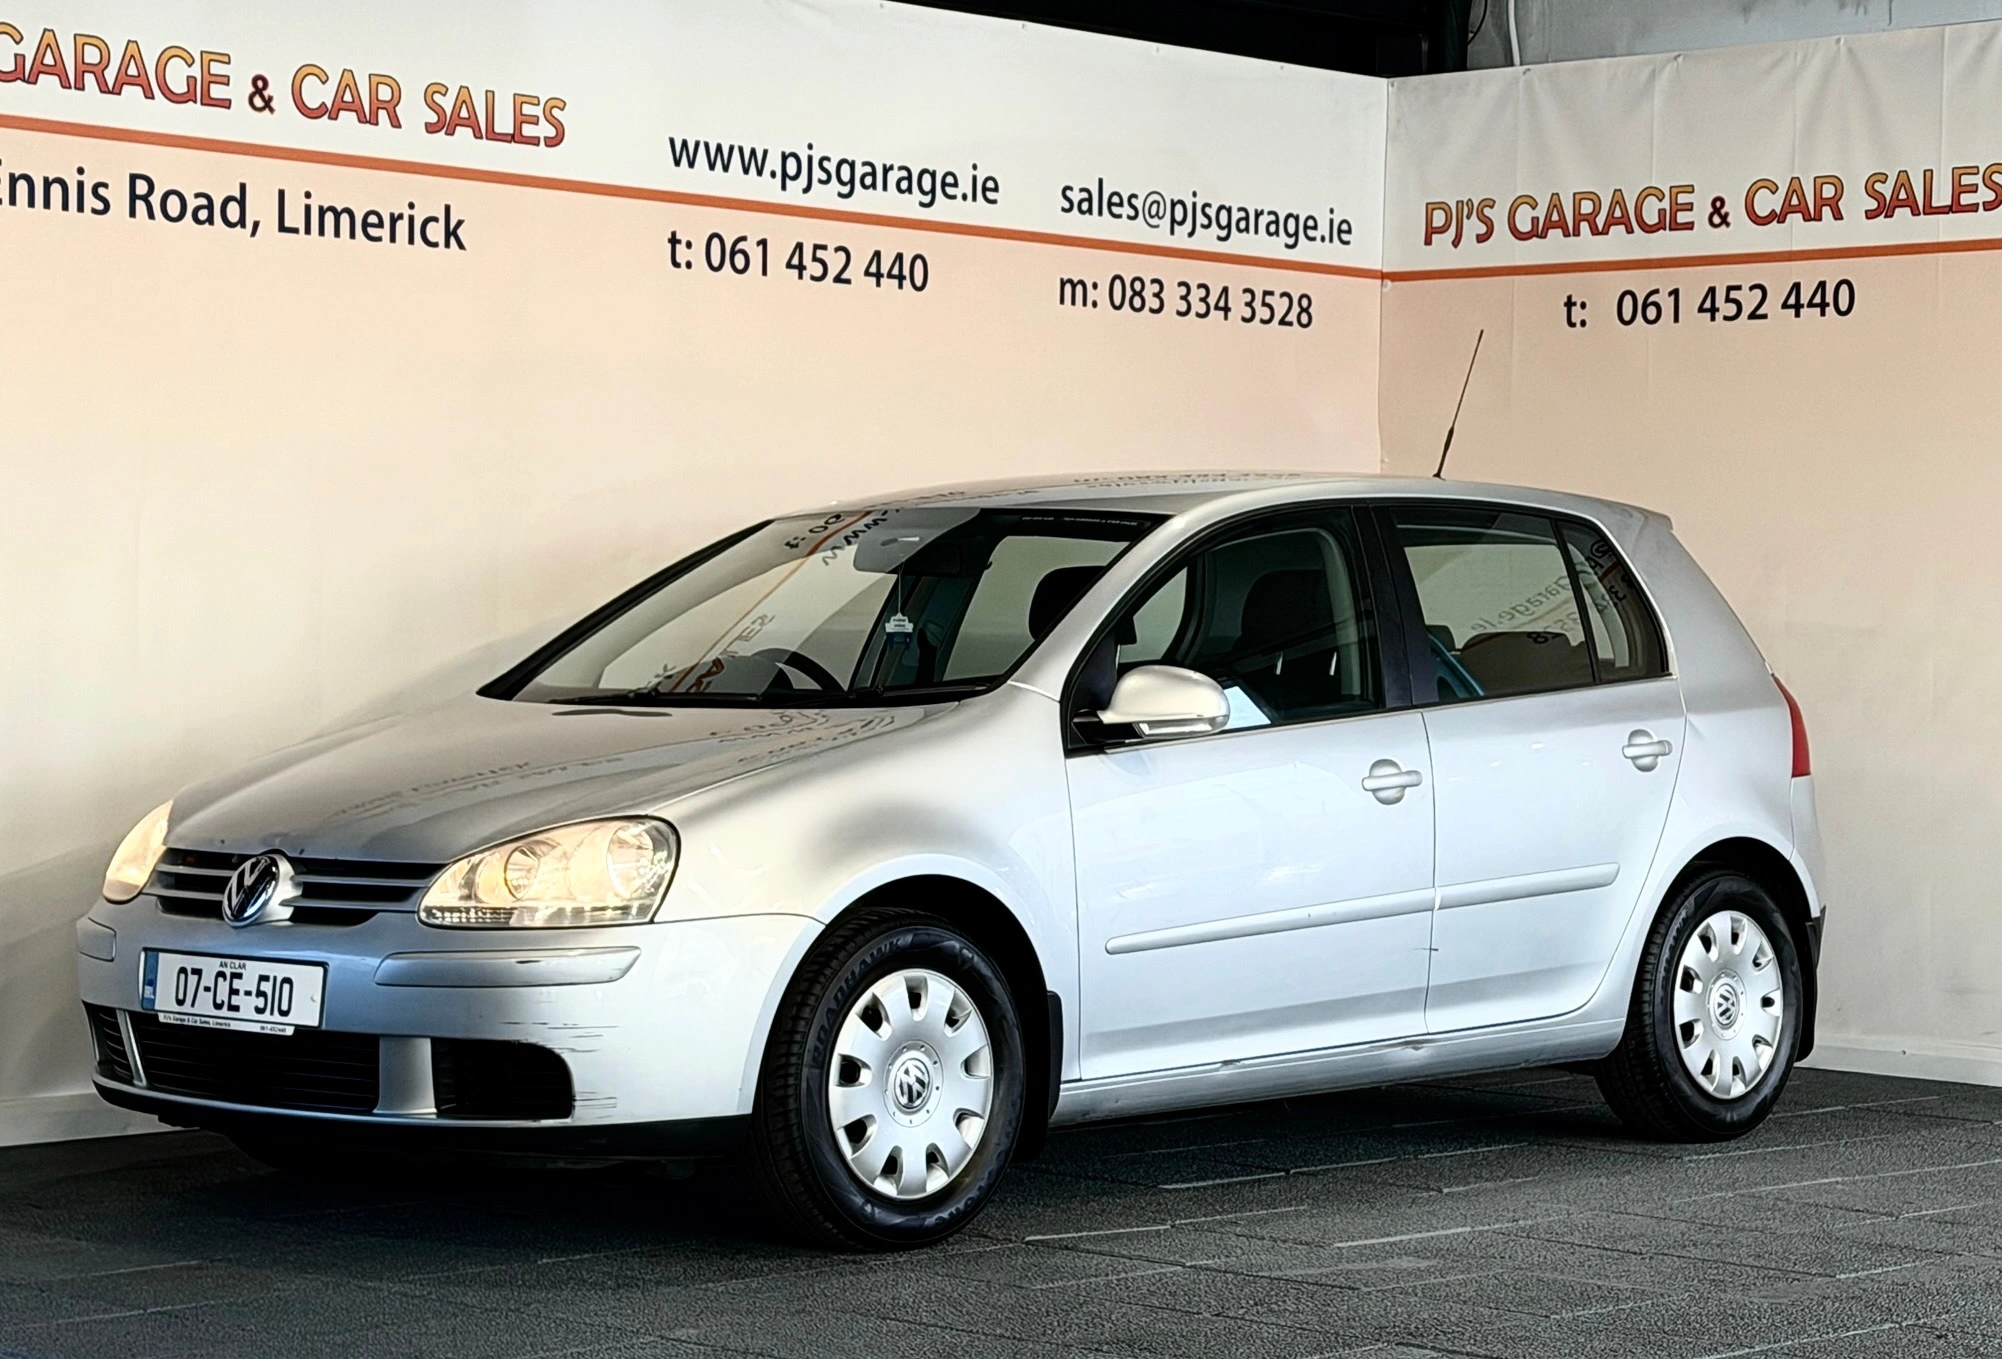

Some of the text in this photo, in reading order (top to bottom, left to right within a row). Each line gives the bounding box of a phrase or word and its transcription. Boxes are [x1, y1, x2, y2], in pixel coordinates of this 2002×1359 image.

[248, 74, 275, 114] &
[291, 63, 402, 129] CAR
[423, 82, 567, 148] SALES
[0, 158, 467, 251] nnis Road, Limerick
[668, 137, 1000, 209] www.pjsgarage.ie
[1424, 163, 2002, 249] PJ'S GARAGE & CAR SALES
[1060, 177, 1352, 250] sales@pjsgarage.ie
[668, 230, 929, 292] t: 061 452 440
[1059, 273, 1313, 329] m: 083 334 3528
[1563, 278, 1856, 329] t: 061 452 440
[174, 966, 294, 1018] 07-CE-510
